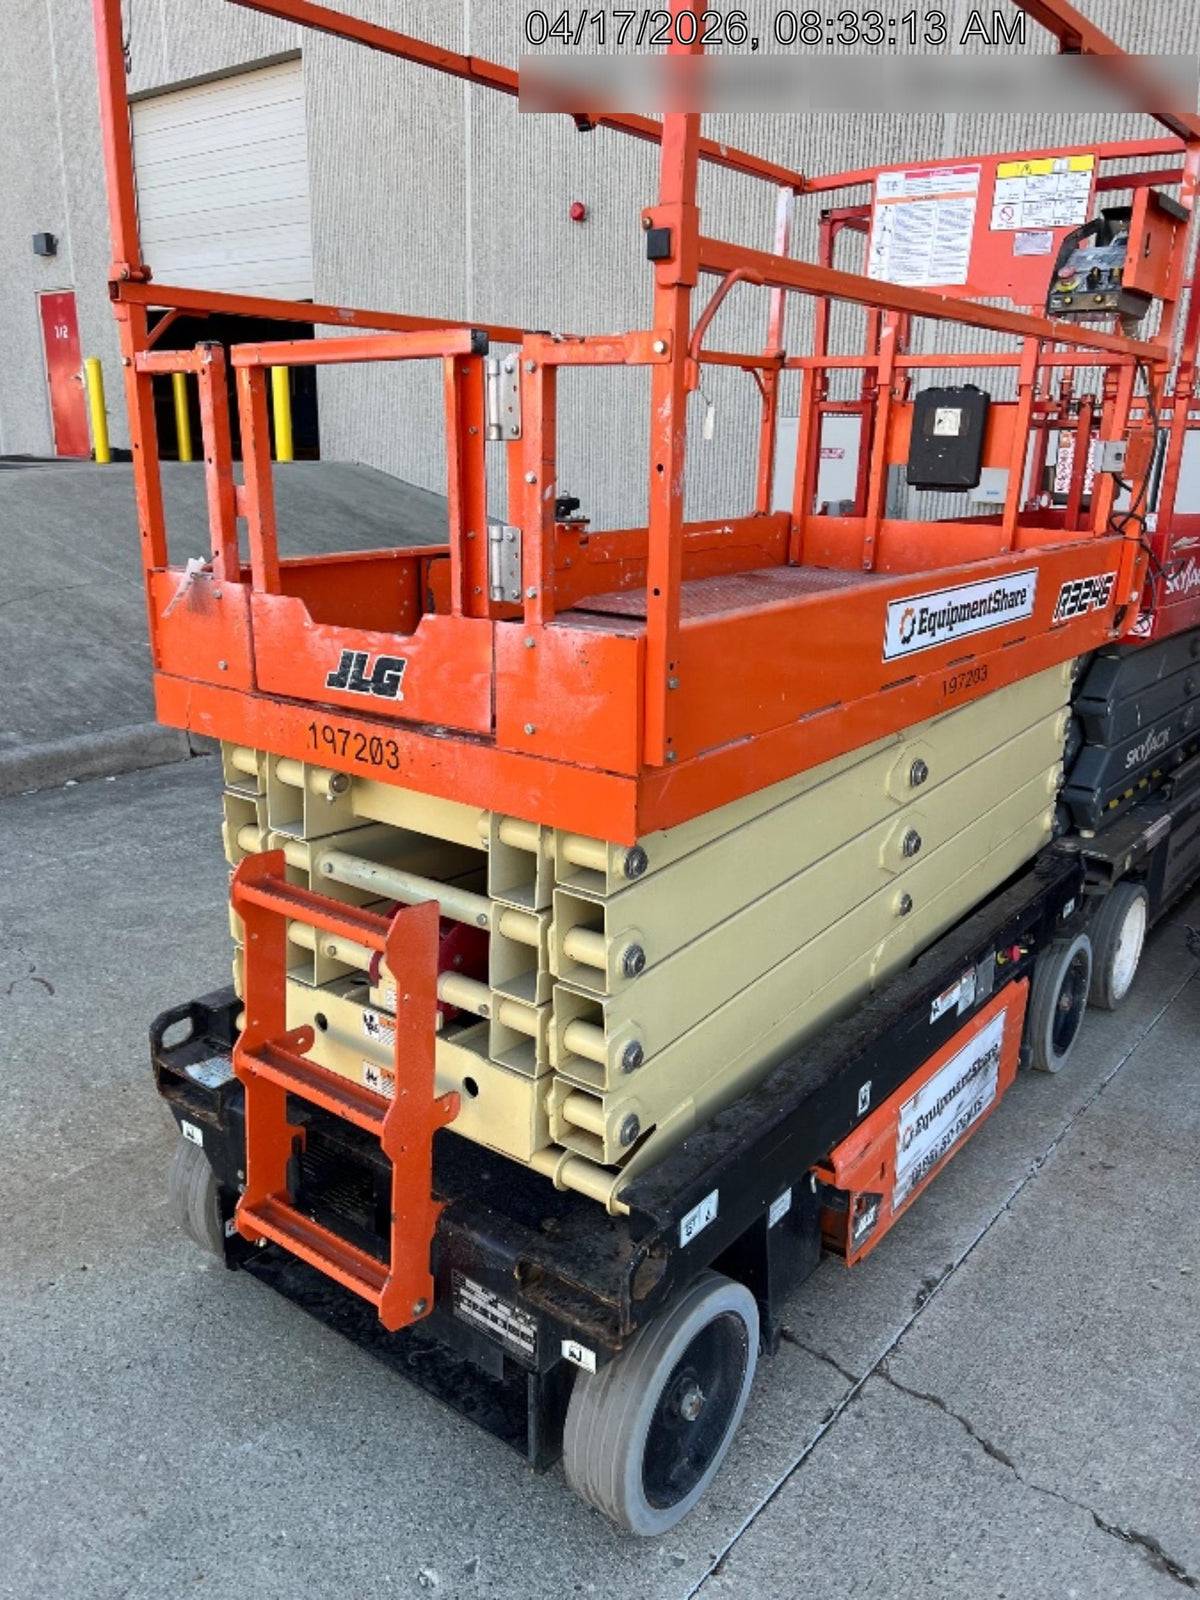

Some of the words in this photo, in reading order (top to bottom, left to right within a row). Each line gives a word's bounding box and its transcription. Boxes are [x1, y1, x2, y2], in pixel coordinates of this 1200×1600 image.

[917, 586, 1027, 635] EquipmentShare
[325, 649, 407, 700] JLG
[943, 665, 989, 696] 197203
[308, 722, 400, 770] 197203
